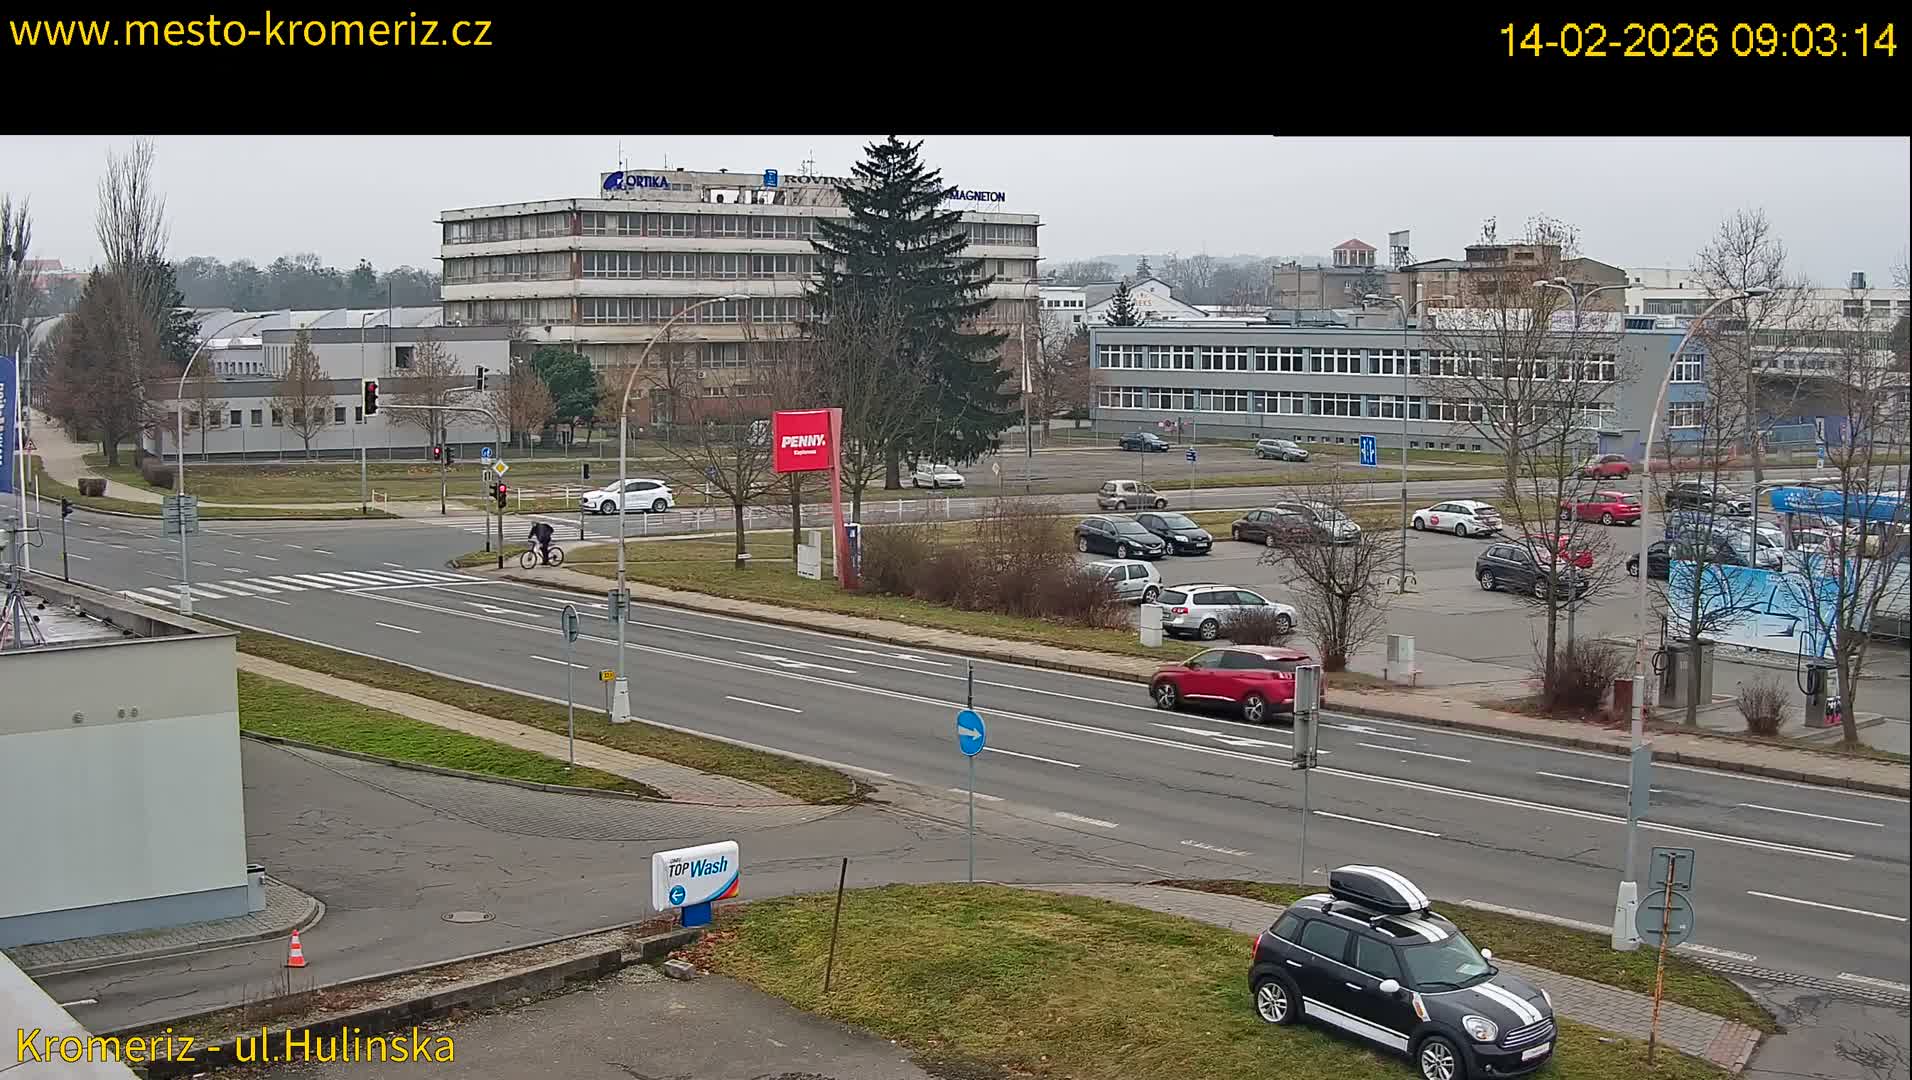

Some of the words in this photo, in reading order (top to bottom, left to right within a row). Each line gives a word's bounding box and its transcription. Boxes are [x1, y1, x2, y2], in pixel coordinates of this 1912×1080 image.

[626, 175, 669, 188] ORTIKA
[950, 190, 1006, 202] MAGNETON
[669, 862, 690, 877] TOP
[690, 855, 728, 878] Wash
